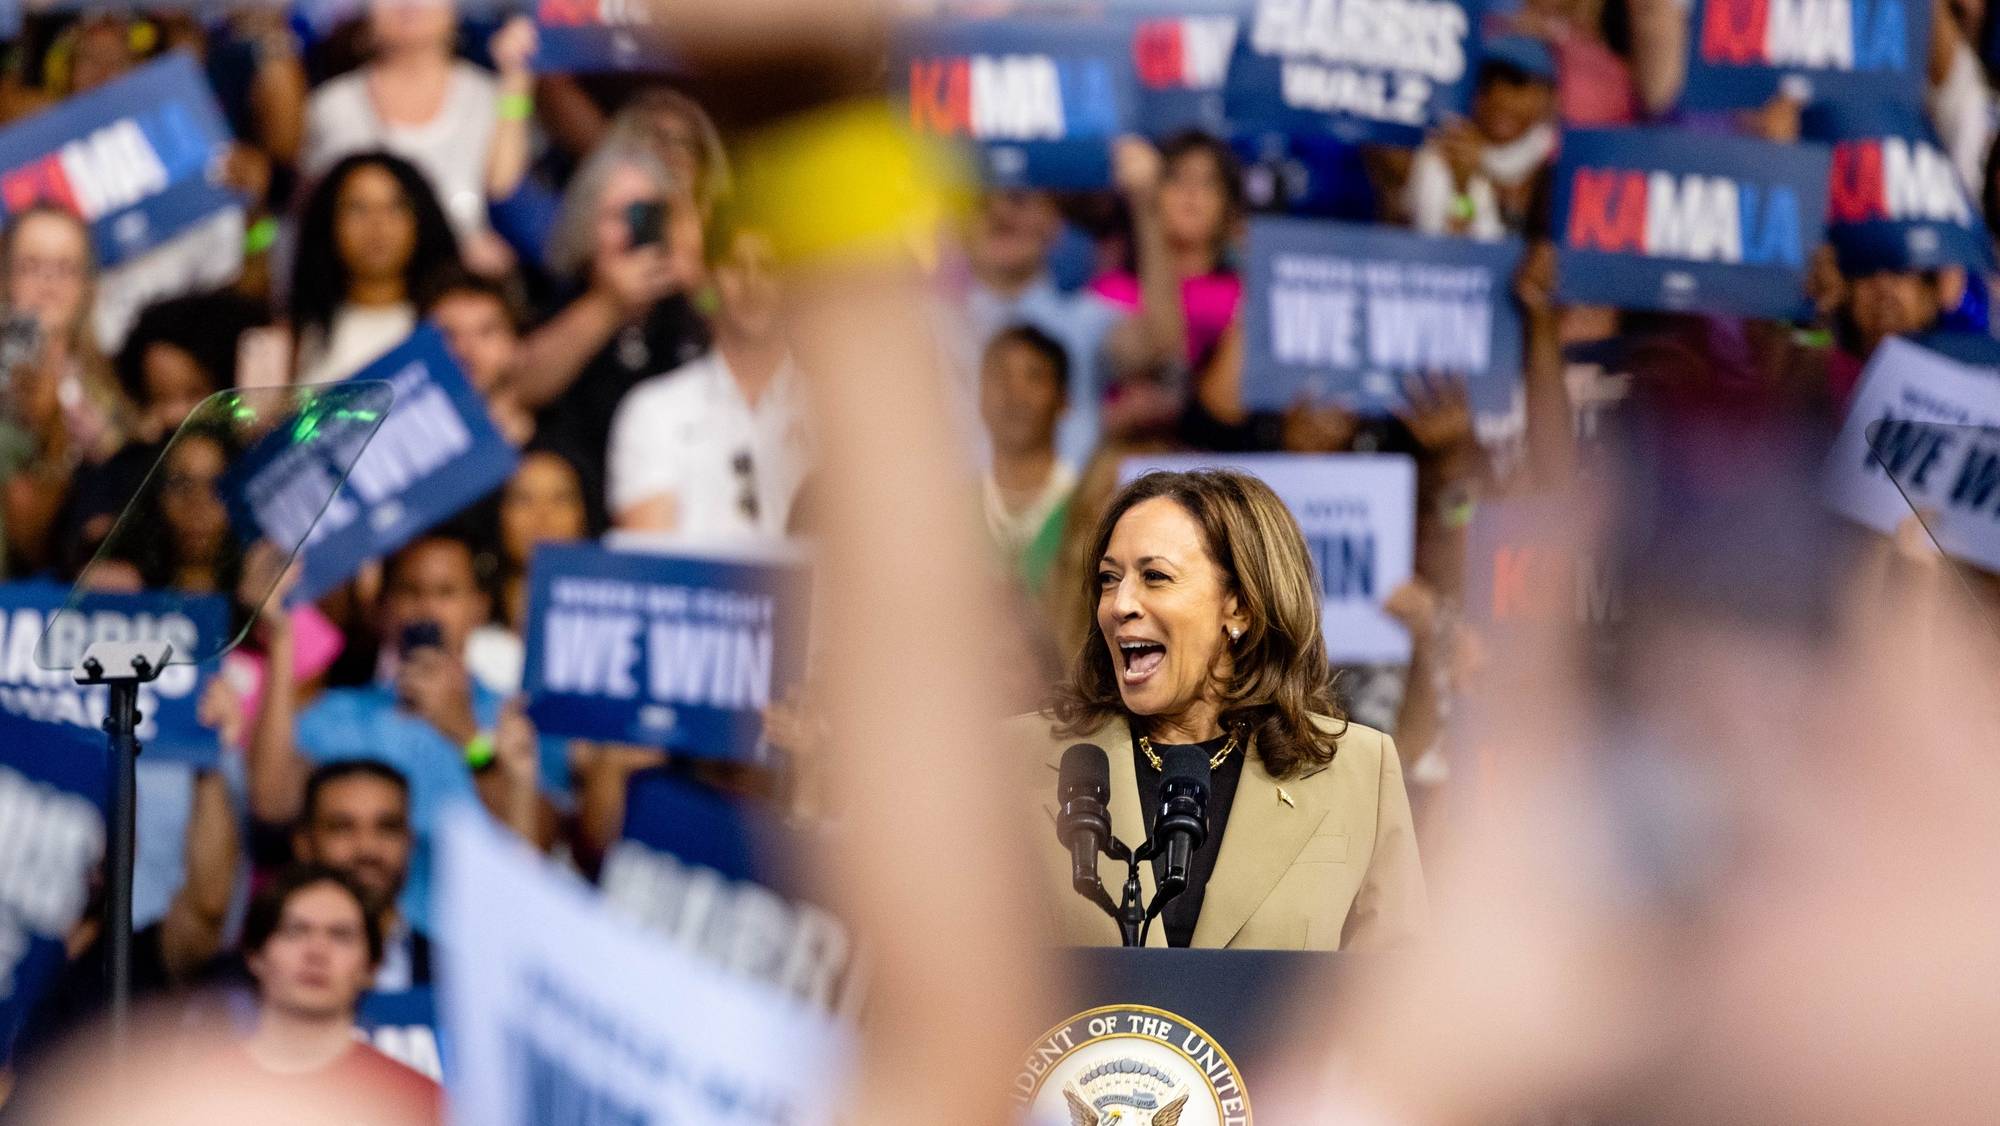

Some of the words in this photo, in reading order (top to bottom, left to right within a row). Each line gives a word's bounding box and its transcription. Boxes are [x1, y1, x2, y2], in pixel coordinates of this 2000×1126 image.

[1567, 165, 1798, 265] KAMALA
[1271, 283, 1359, 368] WE
[1367, 294, 1492, 376] WIN
[1308, 530, 1376, 599] IN
[543, 607, 641, 699] WE
[646, 615, 774, 710] WIN
[1088, 1016, 1117, 1036] OF
[1128, 1015, 1172, 1040] THE
